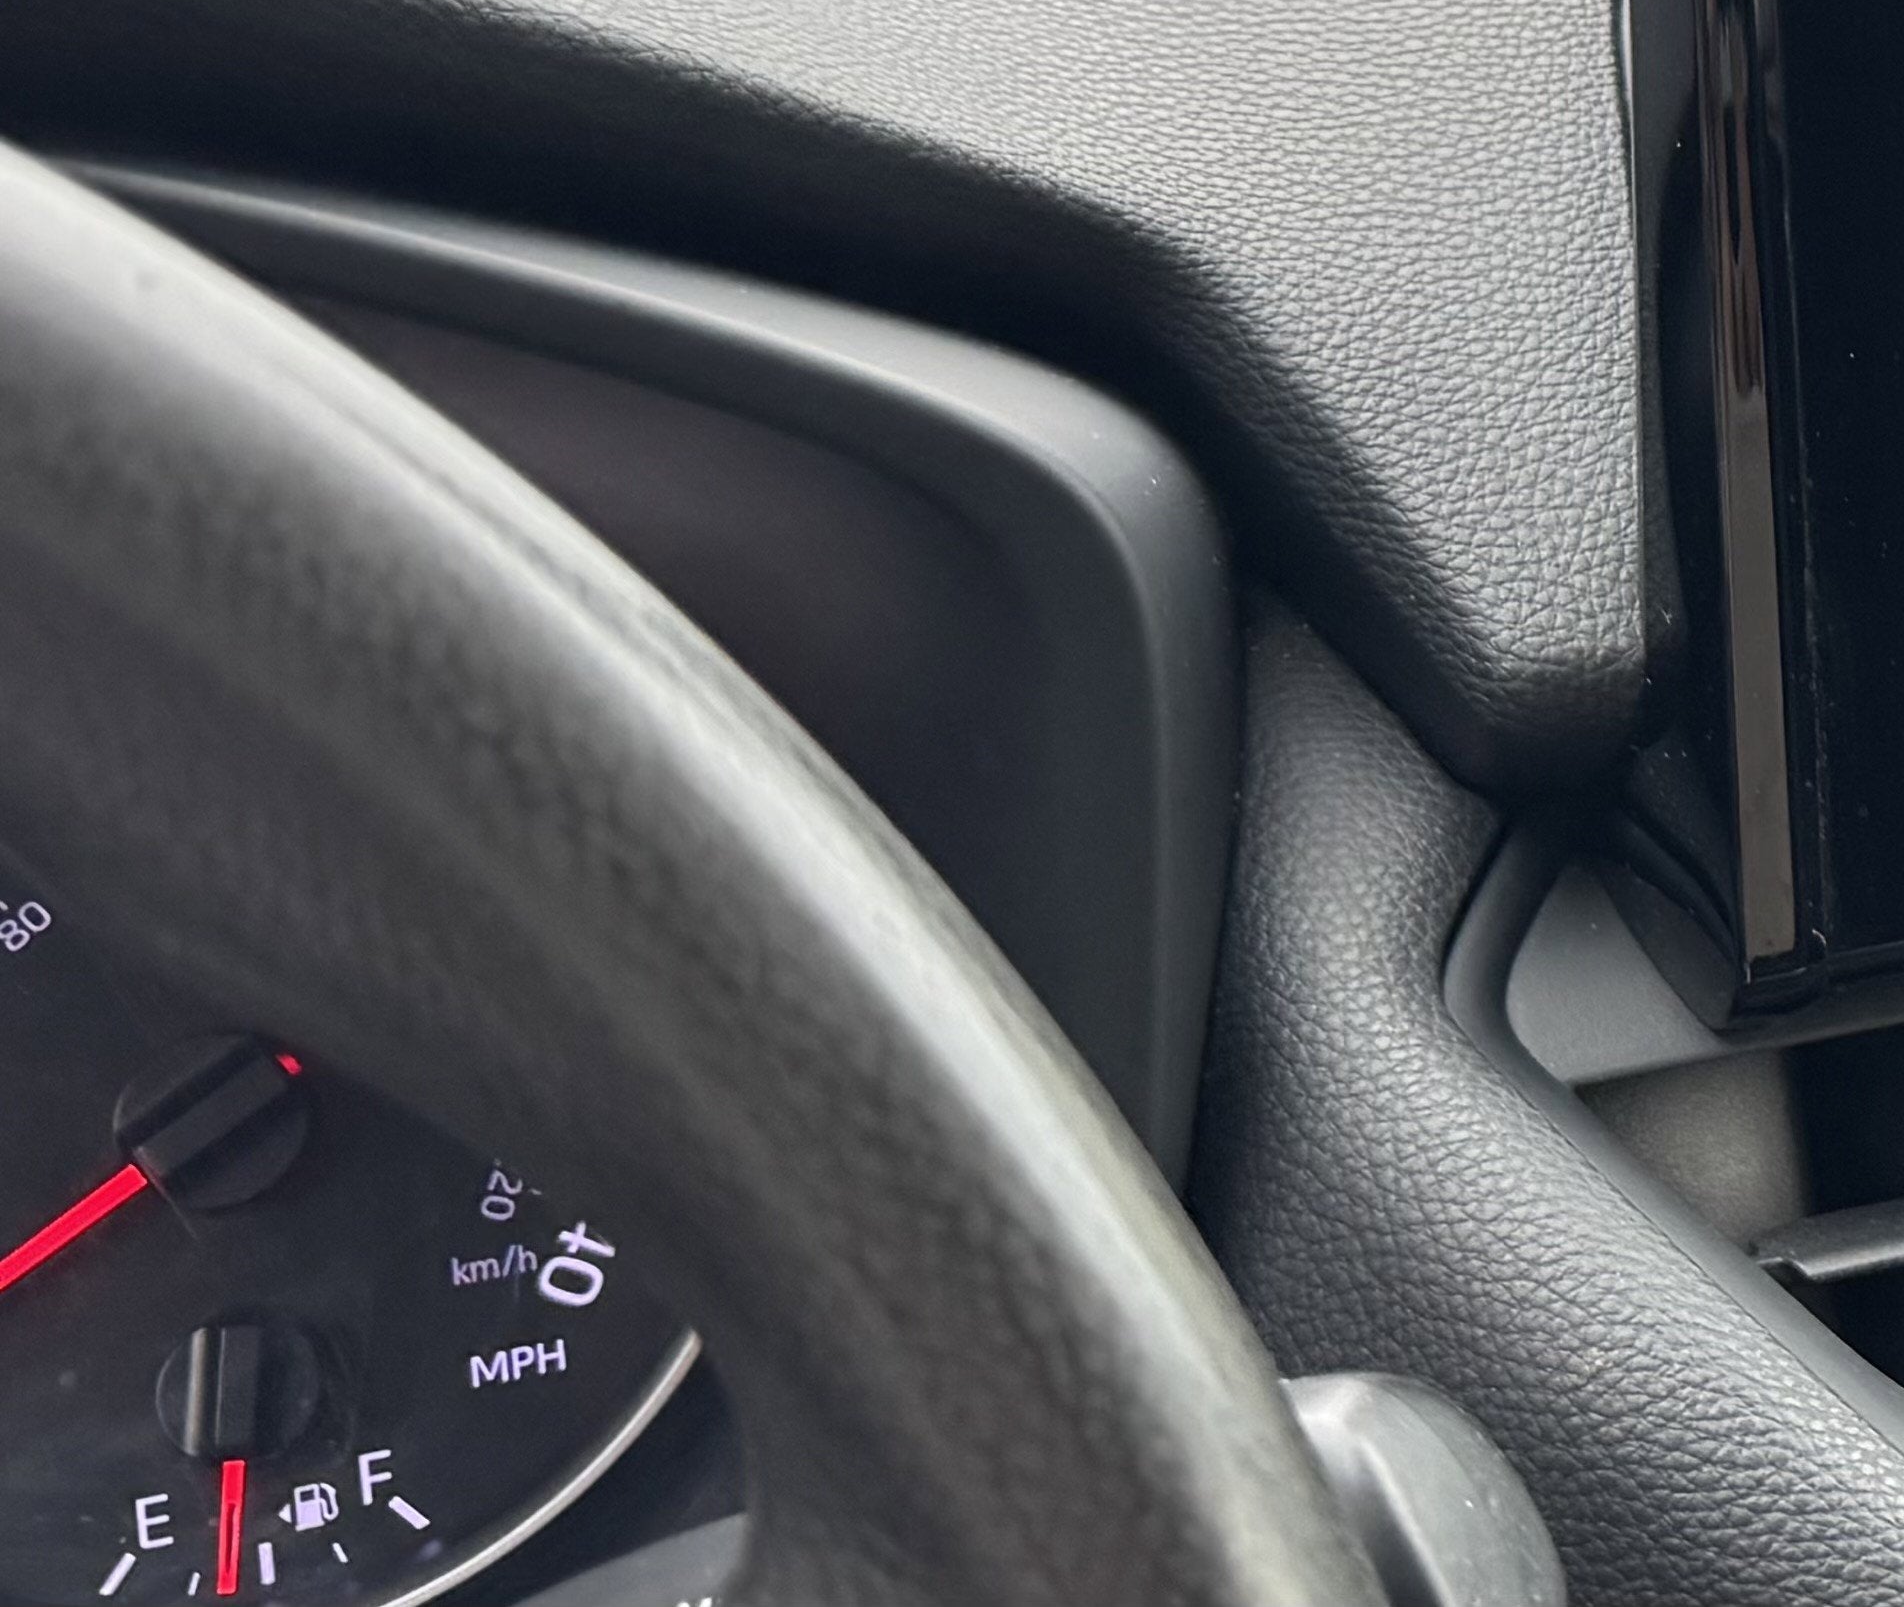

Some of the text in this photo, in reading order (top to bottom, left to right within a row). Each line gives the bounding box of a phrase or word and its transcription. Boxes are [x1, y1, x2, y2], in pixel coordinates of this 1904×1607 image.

[0, 900, 52, 952] 80
[479, 1158, 523, 1221] 20
[451, 1244, 539, 1286] km/h
[538, 1219, 616, 1307] 40
[469, 1339, 567, 1389] MPH
[358, 1449, 393, 1506] F
[135, 1493, 175, 1550] E
